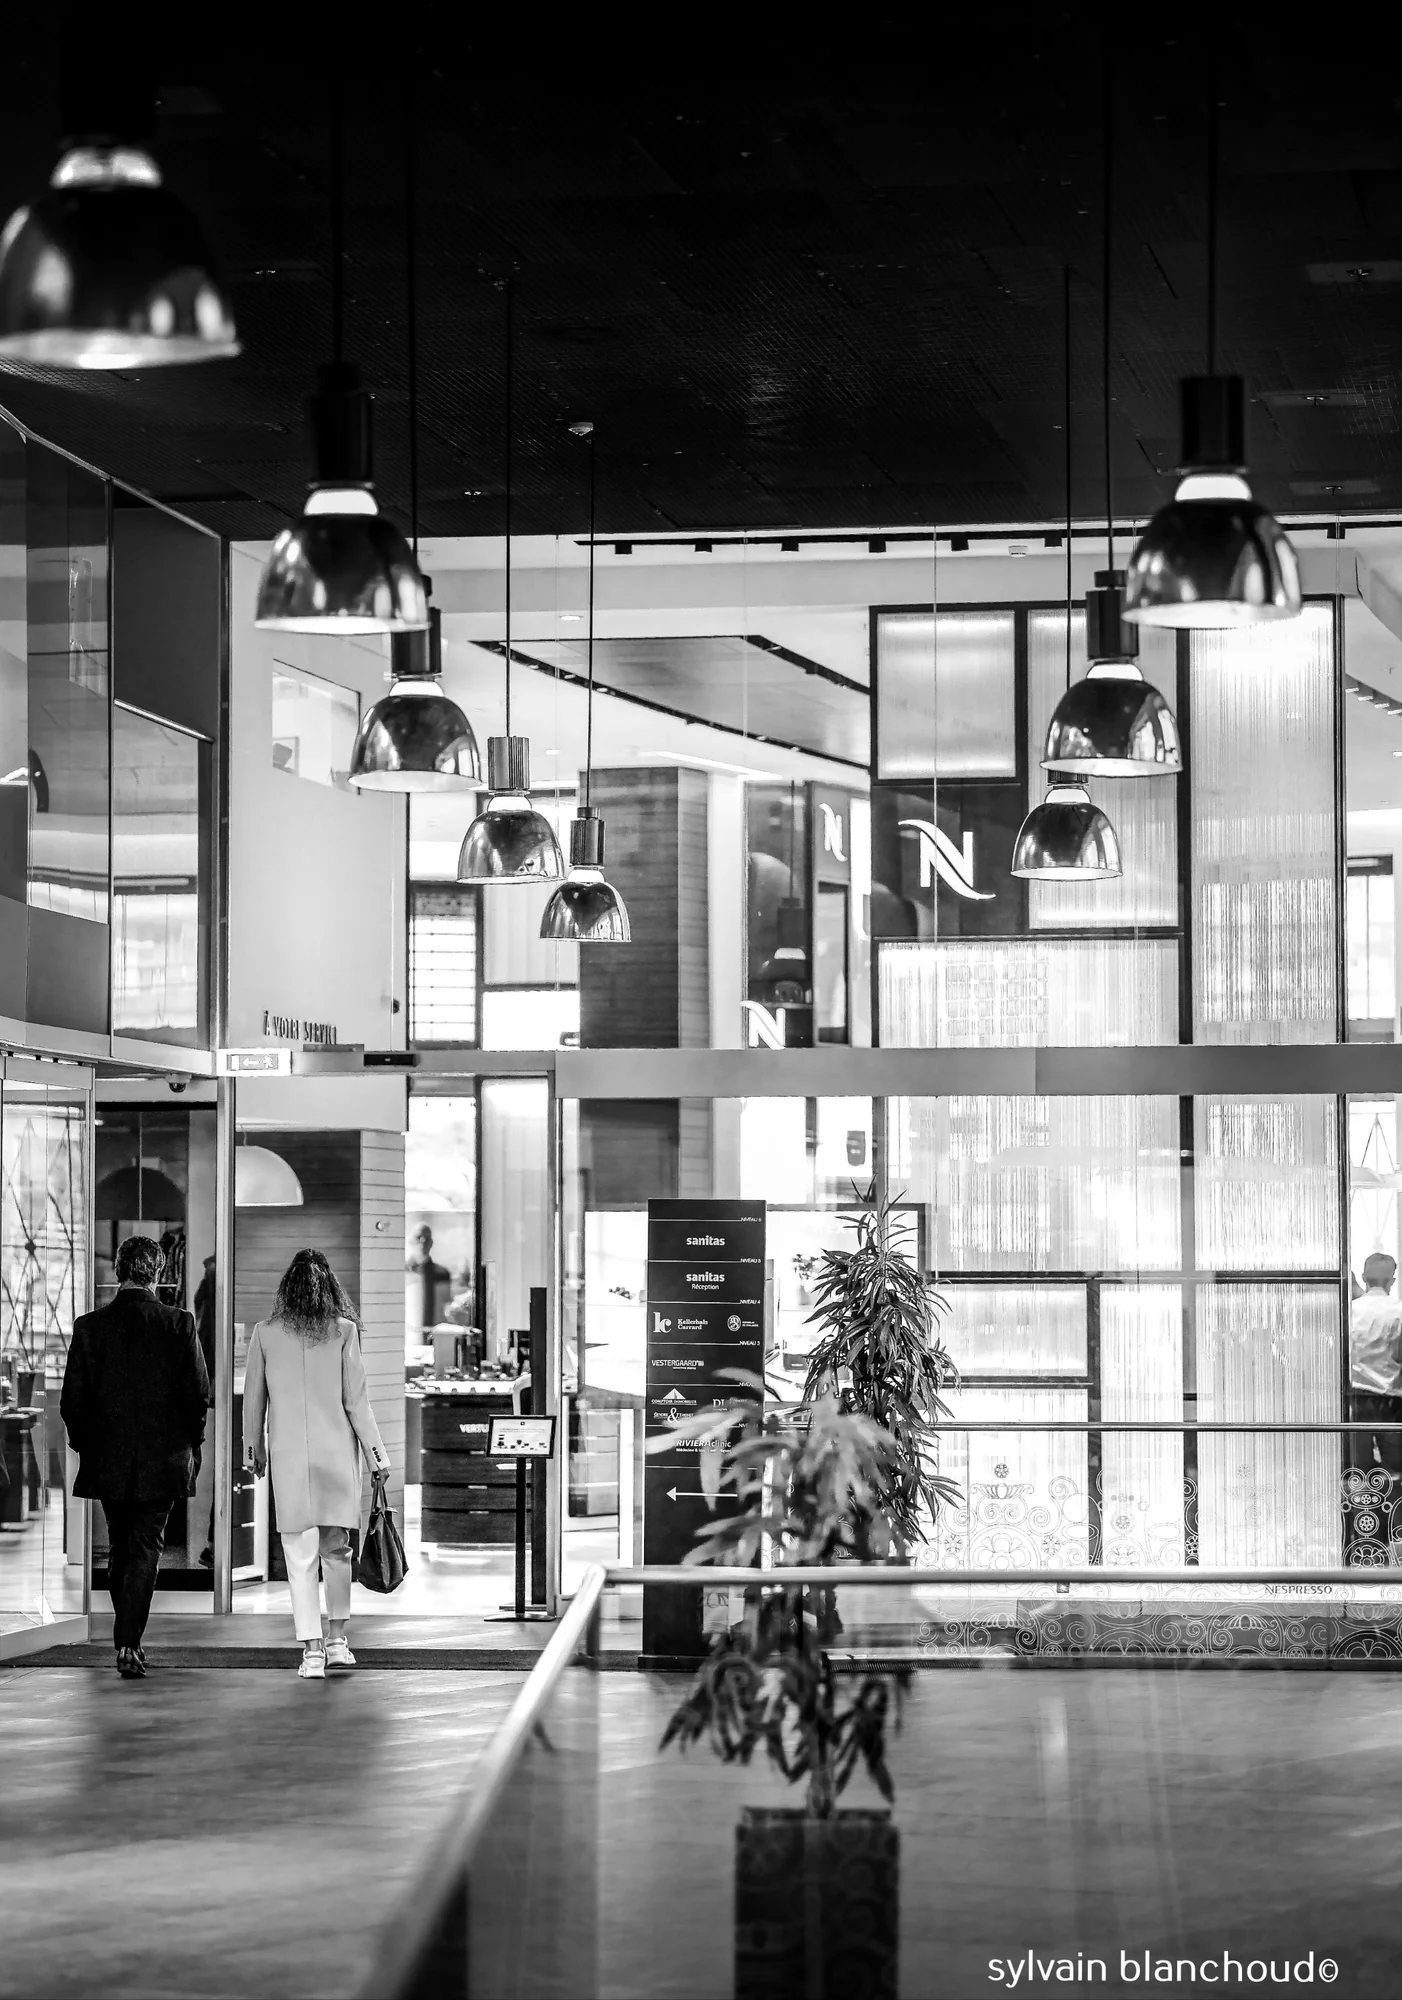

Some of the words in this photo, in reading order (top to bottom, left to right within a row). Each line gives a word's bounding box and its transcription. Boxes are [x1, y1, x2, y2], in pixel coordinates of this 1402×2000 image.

[898, 818, 997, 900] N
[273, 1016, 300, 1041] VOTRE
[686, 1235, 725, 1246] sanitas
[686, 1271, 725, 1282] sanitas
[691, 1283, 720, 1291] Réception
[1265, 1585, 1333, 1595] NESPRESSO
